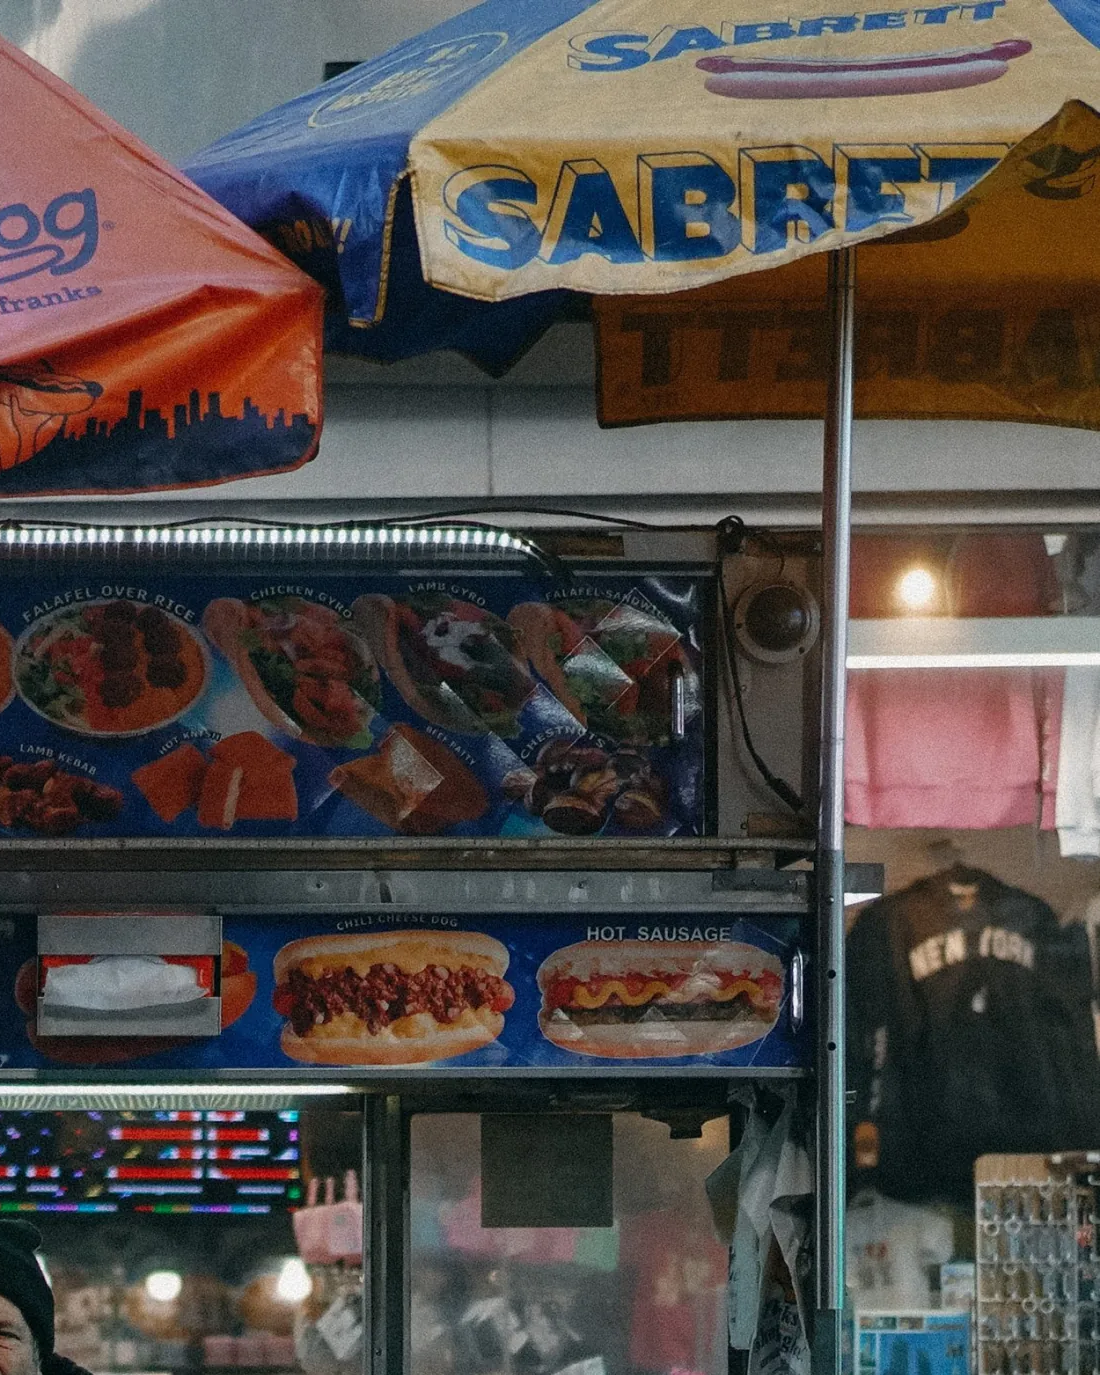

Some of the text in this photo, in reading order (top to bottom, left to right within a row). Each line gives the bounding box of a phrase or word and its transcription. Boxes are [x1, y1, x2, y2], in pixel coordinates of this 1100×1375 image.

[568, 0, 1006, 73] SABRETT
[442, 142, 1004, 270] SABRET
[21, 584, 197, 624] FALAFEL OVER RICE
[249, 584, 353, 619] CHICKEN GYRO
[407, 581, 487, 607] LAMB GYRO
[544, 586, 601, 602] FALAFEL
[19, 743, 98, 777] LAMB KEBAB
[158, 735, 180, 756] HOT
[519, 725, 607, 761] CHESTNUTS
[335, 913, 459, 932] CHILI CHEESE DOG
[586, 925, 732, 942] HOT SAUSAGE
